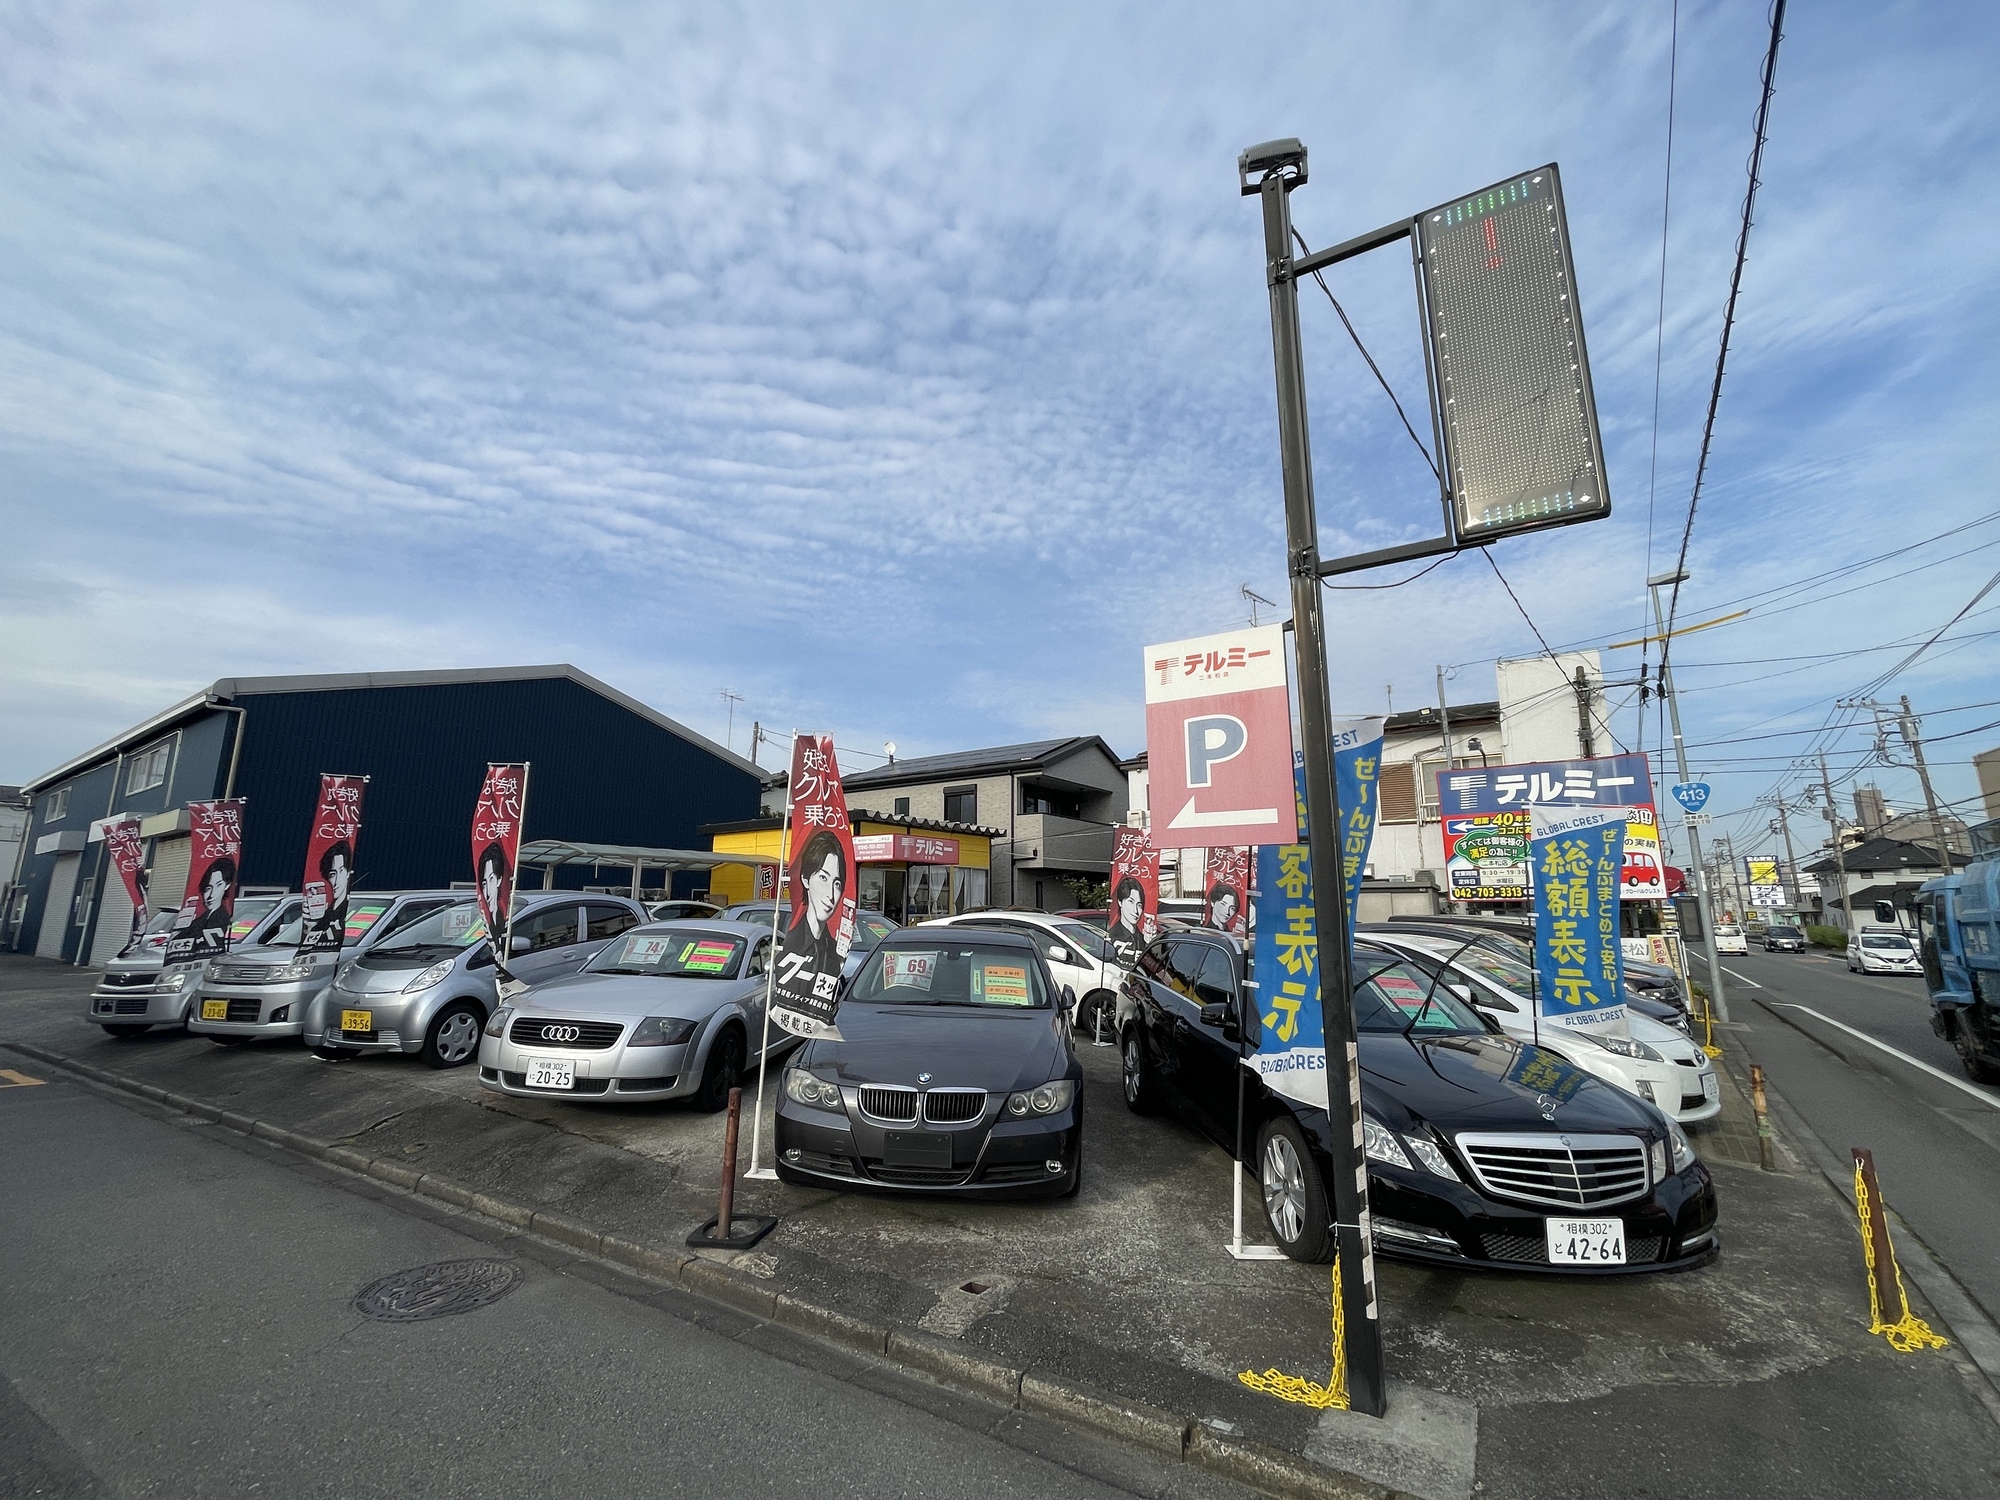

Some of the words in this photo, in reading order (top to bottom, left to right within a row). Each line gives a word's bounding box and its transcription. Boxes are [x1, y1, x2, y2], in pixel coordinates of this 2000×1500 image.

[1183, 647, 1271, 677] テルミー
[1198, 671, 1230, 681] 二本松店
[1183, 713, 1249, 789] P
[803, 748, 831, 774] 好きな
[795, 772, 839, 803] クルマ
[1494, 769, 1635, 805] テルミー
[1679, 789, 1706, 801] 413
[1537, 821, 1572, 837] GLOBAL
[1573, 814, 1605, 832] CREST
[916, 839, 953, 856] テルミー
[1120, 833, 1152, 848] 好きな
[1114, 845, 1158, 864] クルマ
[1454, 888, 1523, 898] 042-703-3313
[1541, 839, 1600, 1006] 総額表示
[907, 959, 927, 974] 69
[348, 1018, 369, 1030] 39-56
[780, 1012, 813, 1034] 掲載店
[1565, 1013, 1600, 1026] GLOBAL
[1600, 1009, 1626, 1022] CREST
[1289, 1054, 1326, 1070] CRES
[536, 1070, 571, 1086] 20-25
[1567, 1223, 1608, 1235] 相模302
[1554, 1242, 1563, 1254] と
[1567, 1237, 1622, 1260] 42-64
